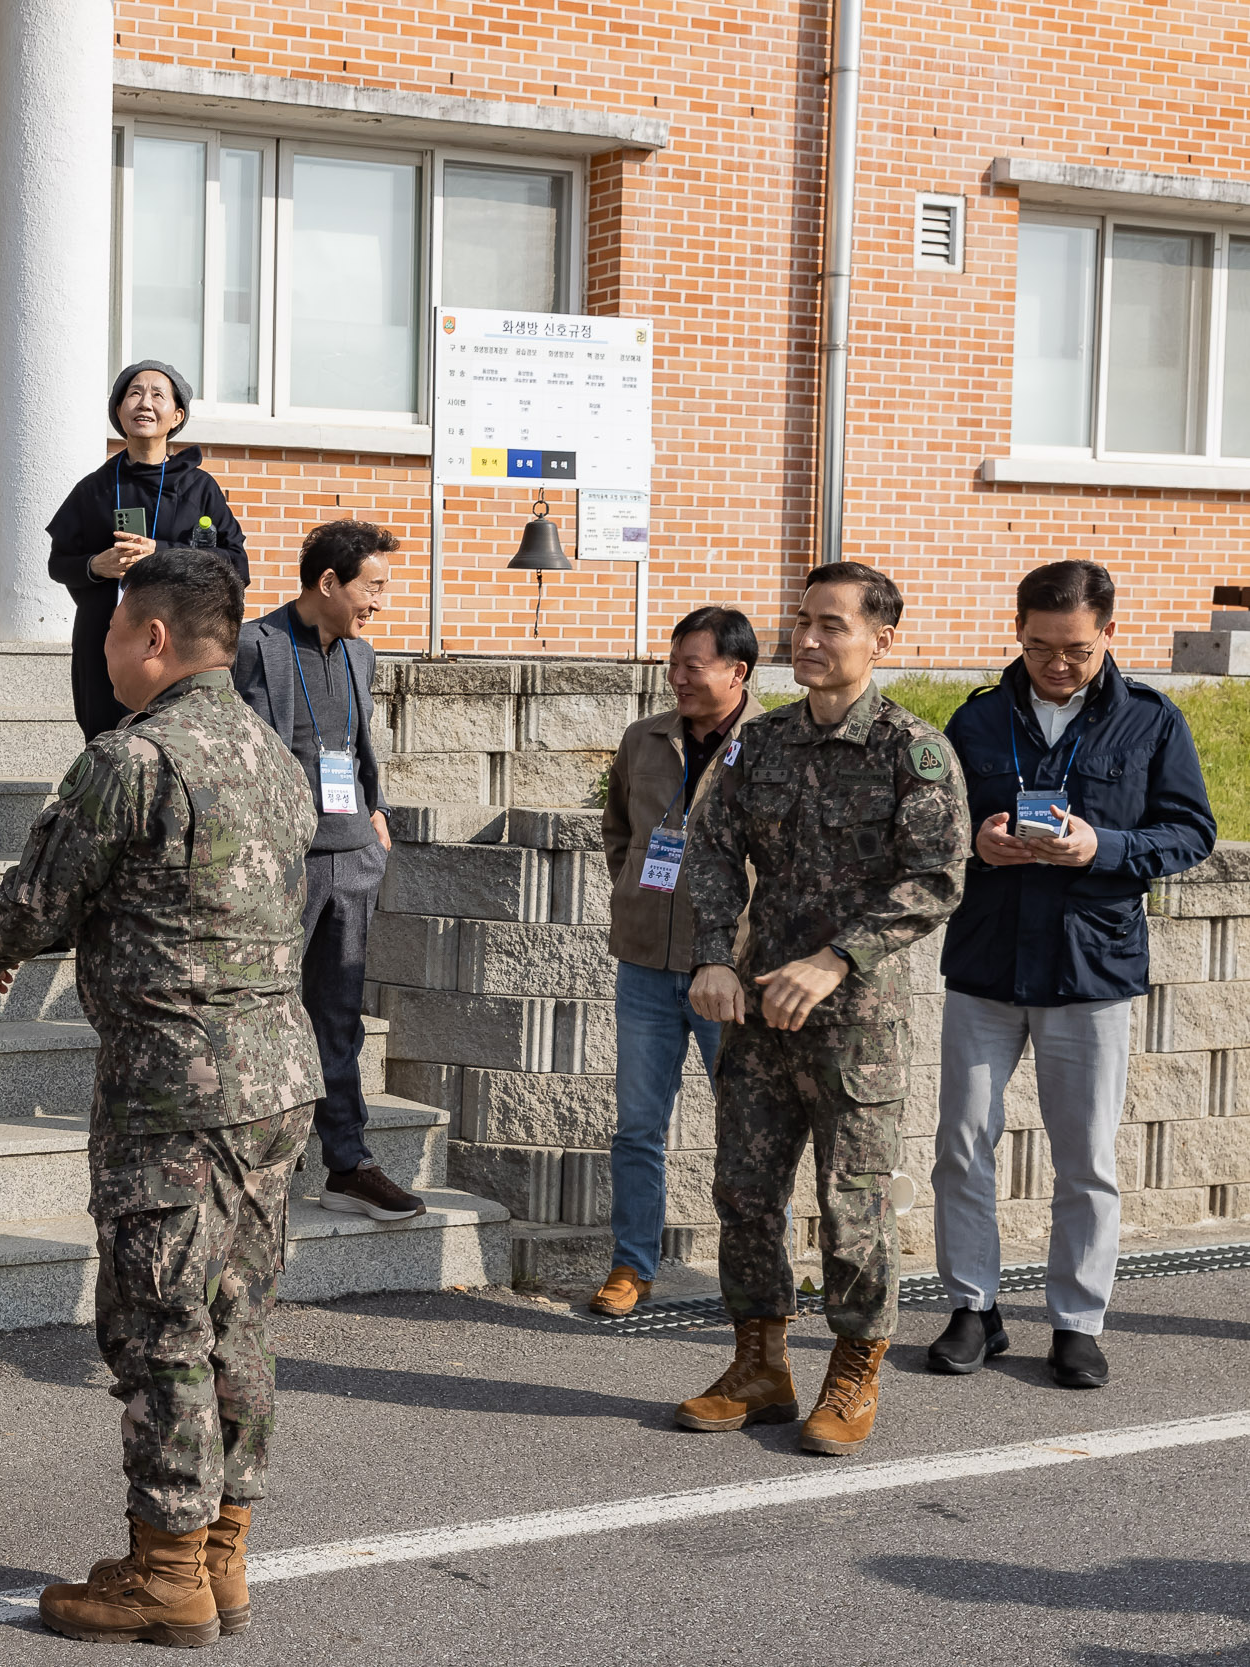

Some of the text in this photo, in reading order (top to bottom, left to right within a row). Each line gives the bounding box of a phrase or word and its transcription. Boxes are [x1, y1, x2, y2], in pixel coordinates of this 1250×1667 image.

[502, 319, 592, 338] 화생방 신호규정
[447, 399, 466, 407] 사이렌
[647, 869, 671, 882] 송수종
